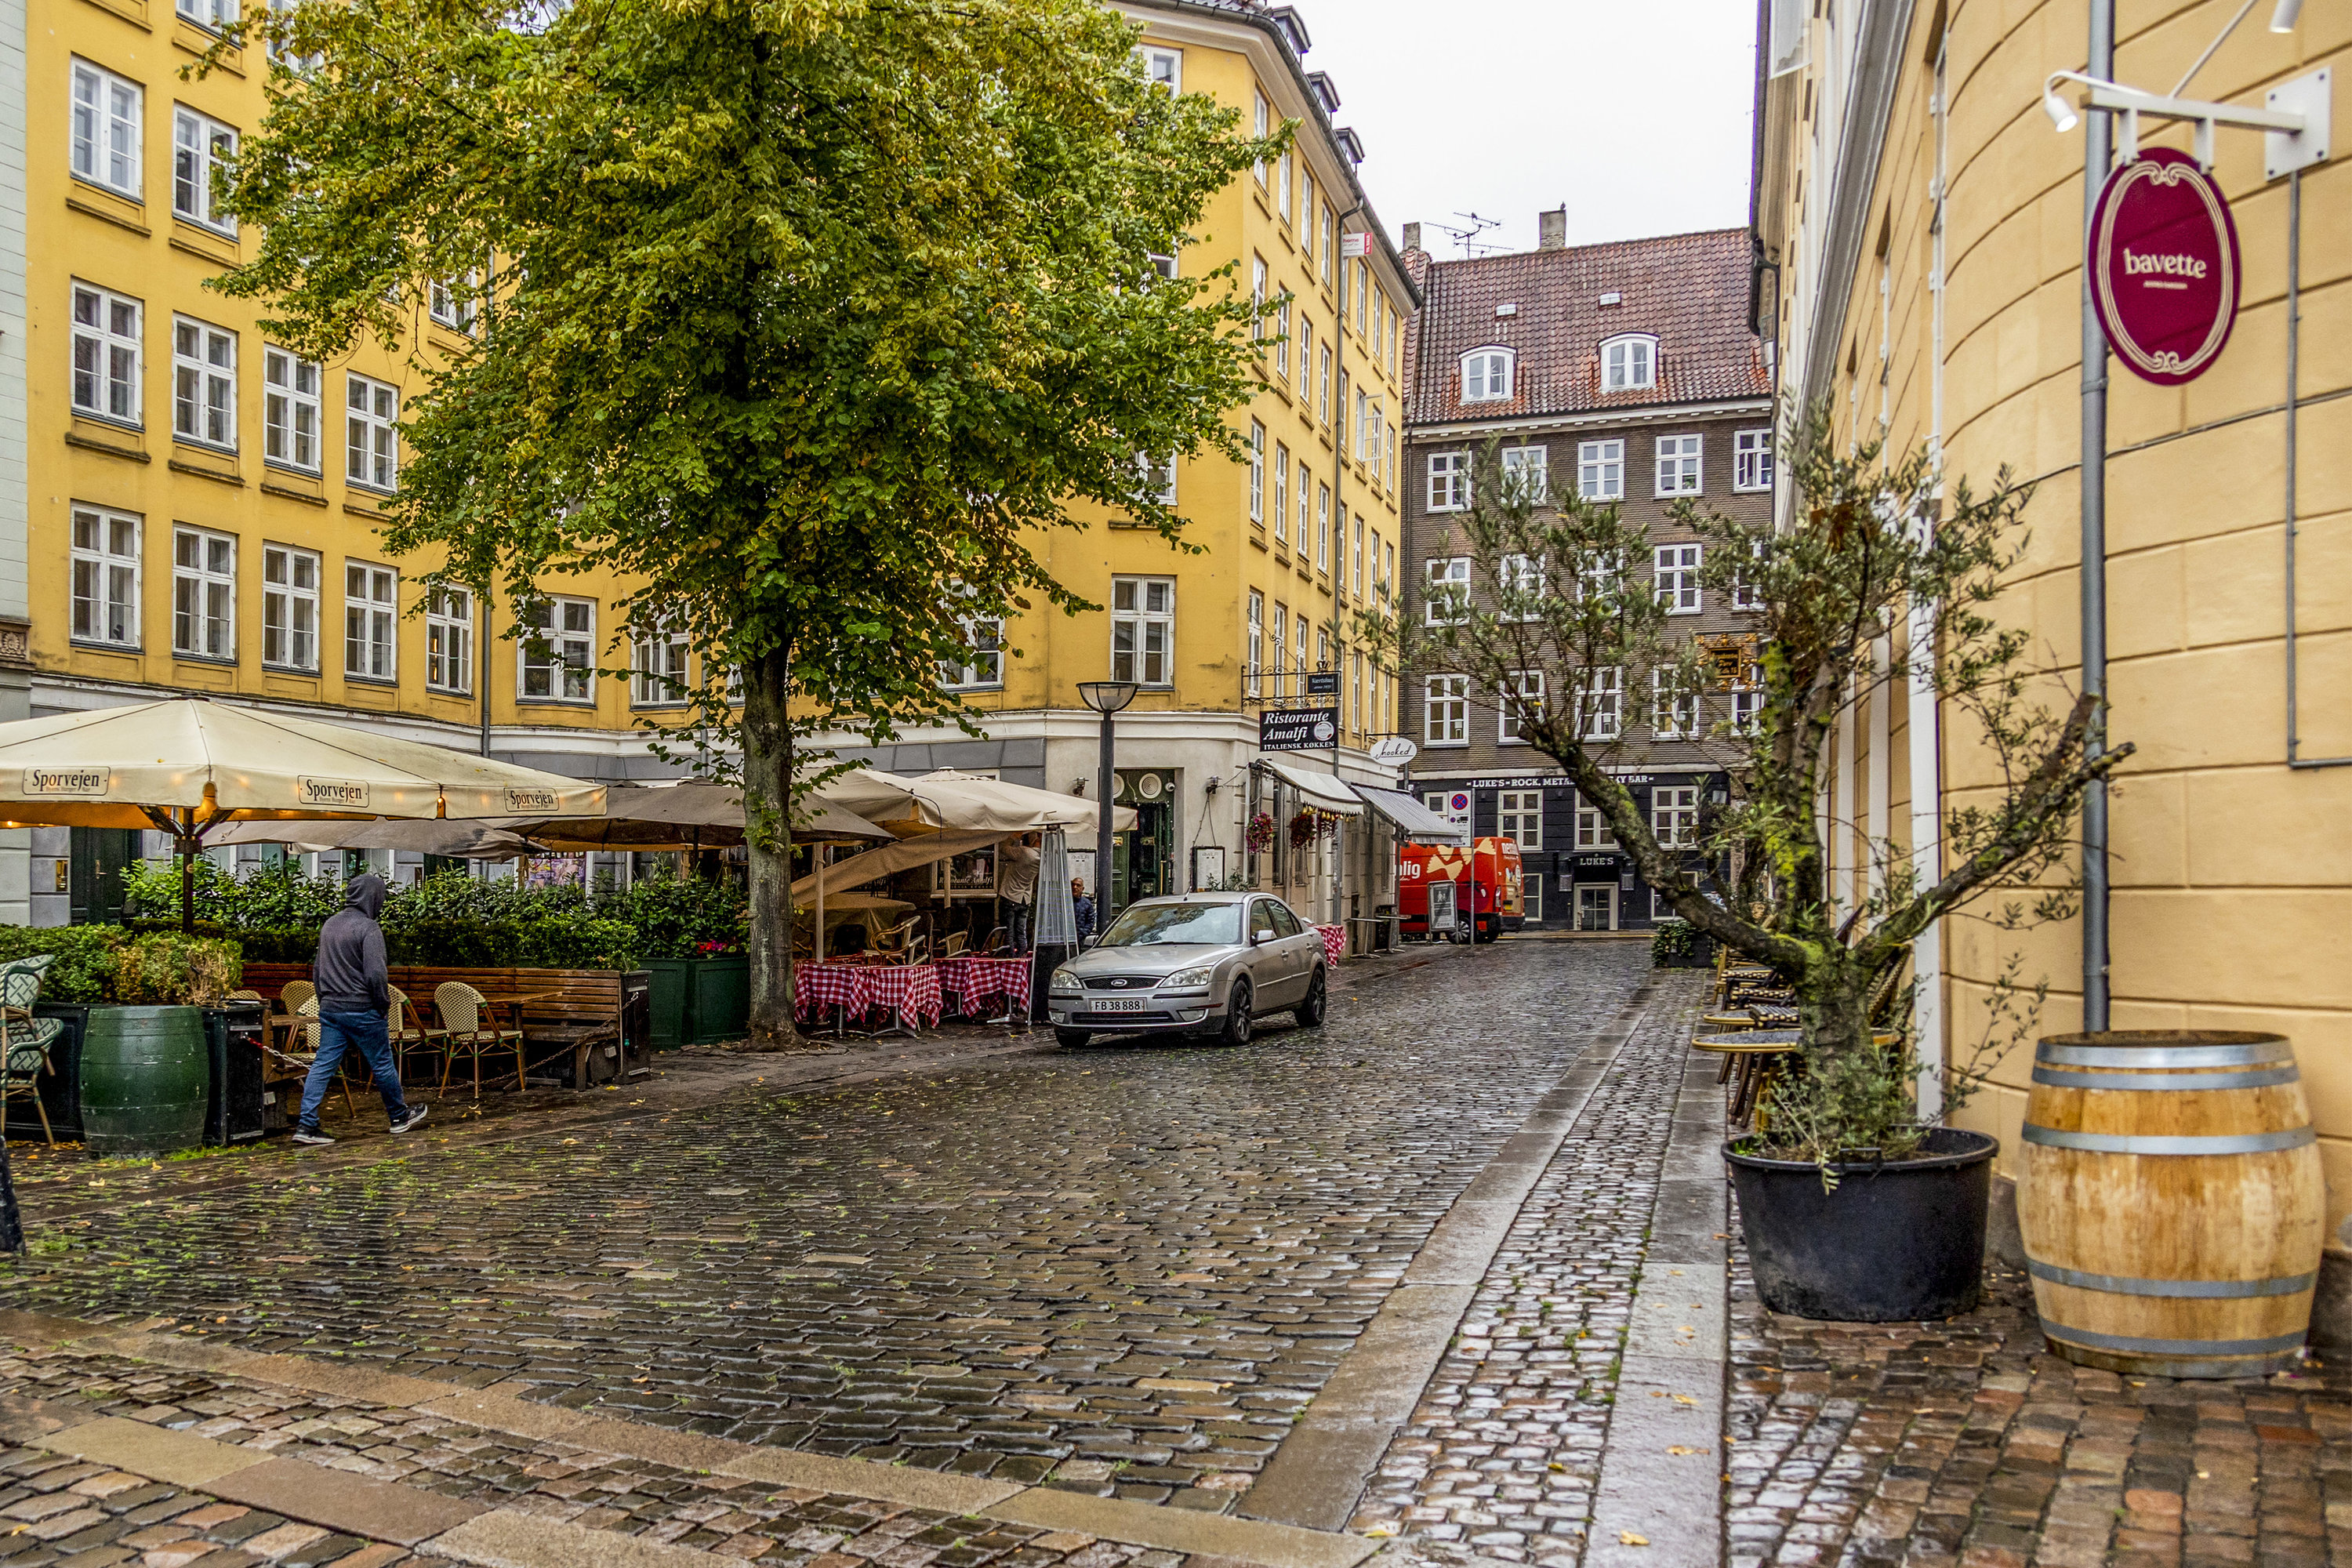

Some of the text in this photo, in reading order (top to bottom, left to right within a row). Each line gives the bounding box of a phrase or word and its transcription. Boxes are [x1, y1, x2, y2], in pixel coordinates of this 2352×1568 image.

[2123, 247, 2207, 279] bavette
[1264, 711, 1330, 724] Ristorante
[1263, 726, 1308, 742] Amalfi
[1374, 741, 1412, 760] hooked
[32, 769, 100, 792] Sporvejen
[307, 779, 362, 803] Sporvejen
[510, 790, 554, 808] Sporvejen
[1580, 857, 1613, 866] LUKE'S
[1094, 1001, 1140, 1011] FB 38 888
